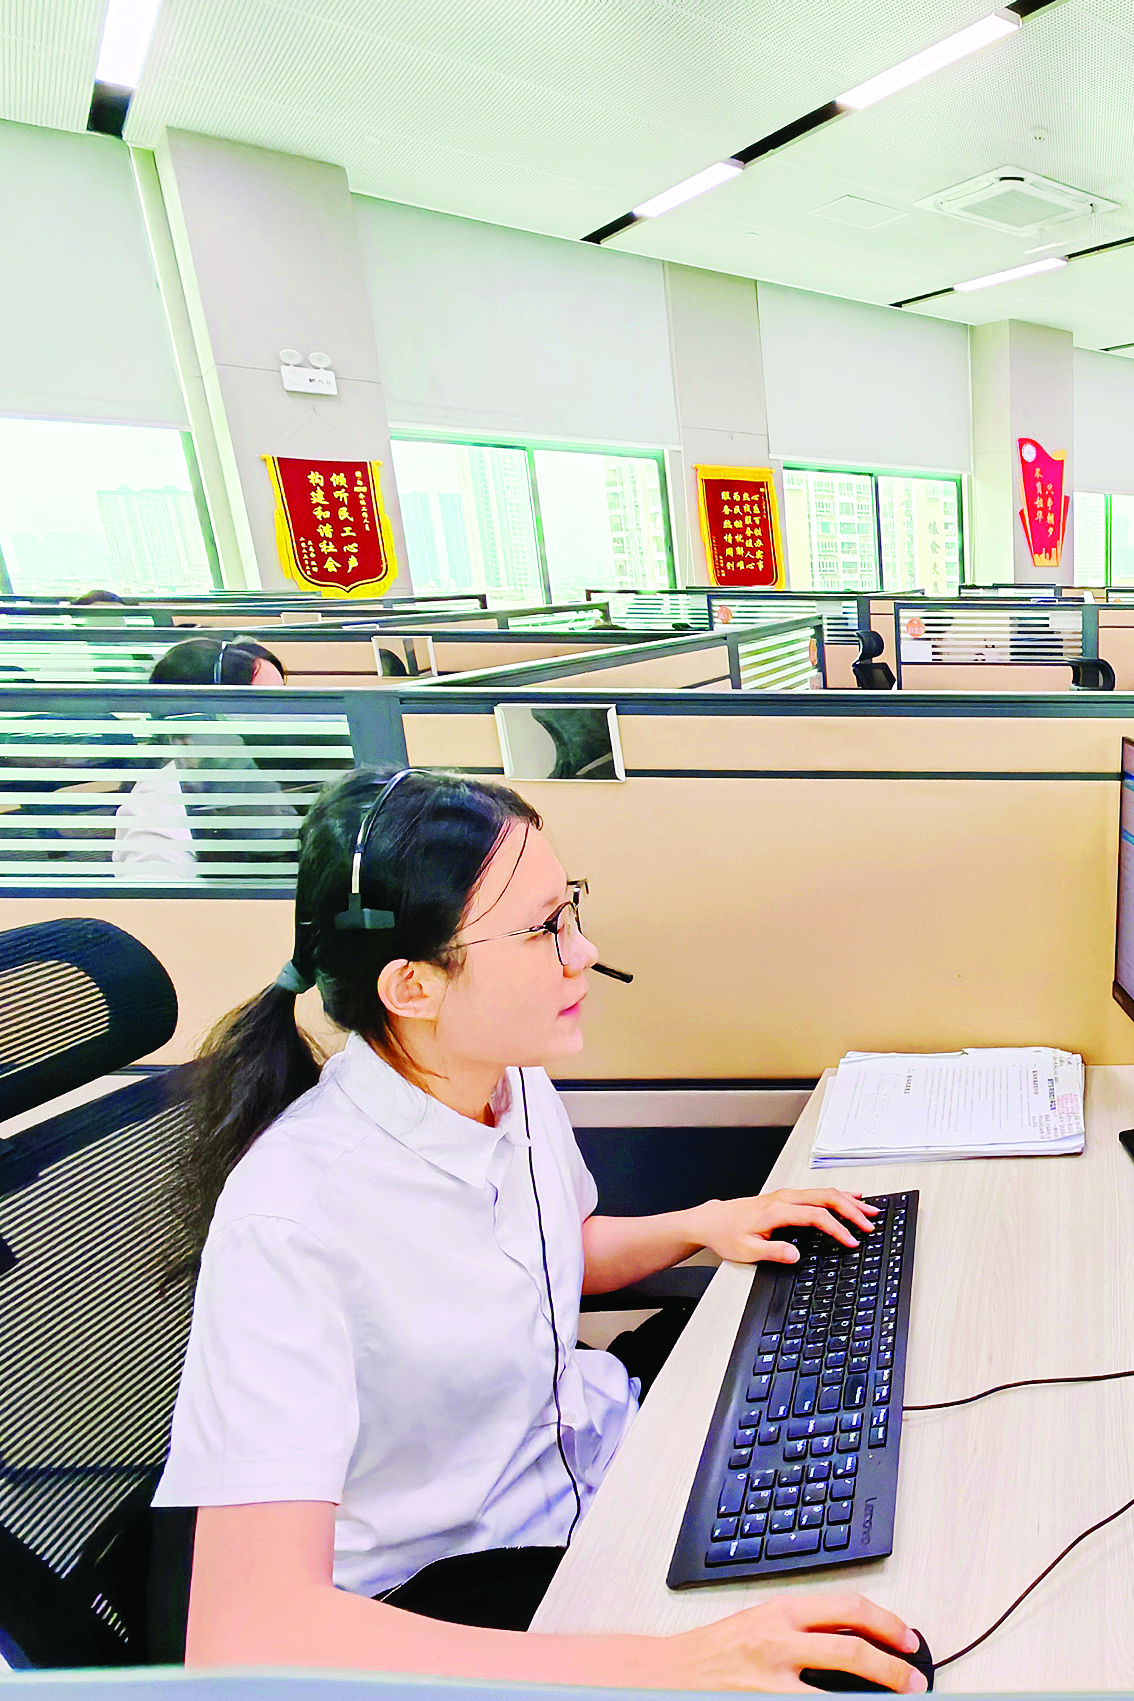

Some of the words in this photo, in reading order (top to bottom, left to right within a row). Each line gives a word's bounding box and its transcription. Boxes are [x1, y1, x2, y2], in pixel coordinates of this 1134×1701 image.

[307, 471, 342, 573] 构建和谐社会
[330, 472, 359, 573] 倾听民工心声
